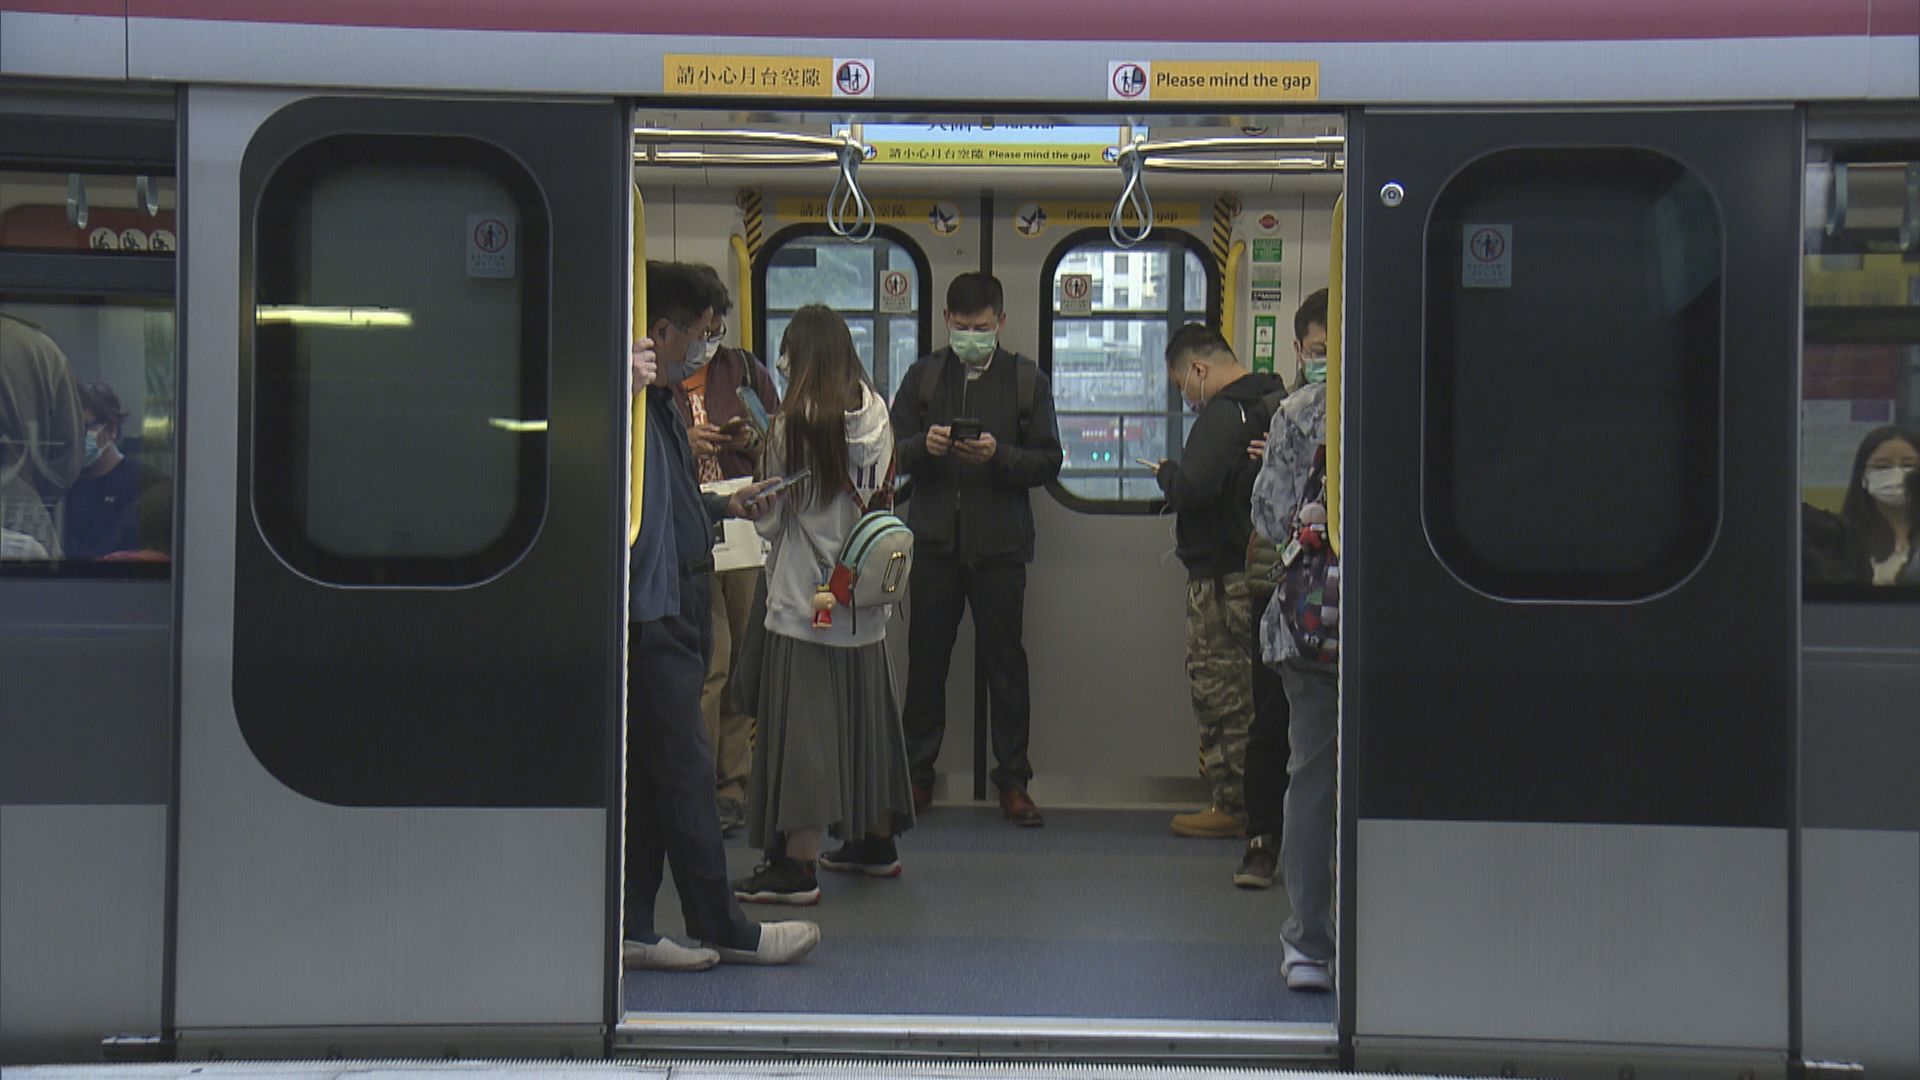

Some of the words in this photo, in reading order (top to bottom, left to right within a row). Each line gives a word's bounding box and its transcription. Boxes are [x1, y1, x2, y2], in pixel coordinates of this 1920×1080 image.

[677, 65, 821, 87] 請小心月台空隙
[1156, 72, 1205, 87] Please
[1209, 72, 1249, 87] mind
[1253, 72, 1278, 87] the
[1282, 76, 1312, 91] gap
[988, 150, 1021, 160] Please
[1023, 150, 1051, 160] mind
[1052, 151, 1070, 160] the
[1071, 152, 1091, 163] gap
[1066, 208, 1101, 220] Please
[1156, 211, 1178, 223] gap
